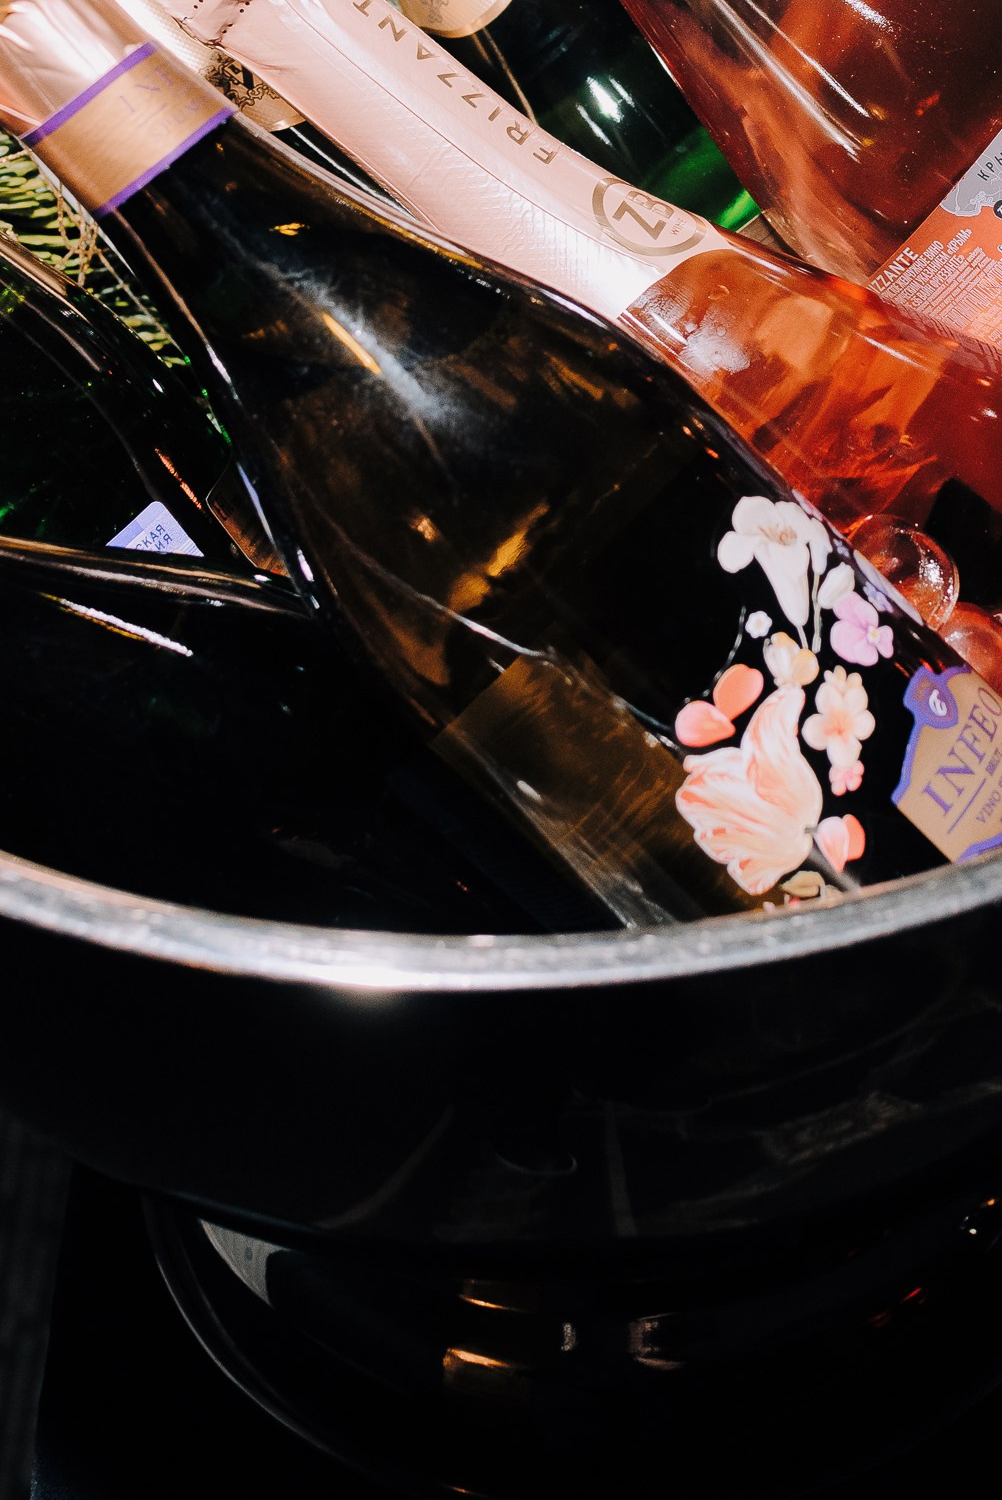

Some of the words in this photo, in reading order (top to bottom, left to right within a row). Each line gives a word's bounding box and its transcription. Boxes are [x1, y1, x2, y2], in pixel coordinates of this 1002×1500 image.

[611, 186, 674, 240] ZB
[866, 245, 918, 296] IZZANTE
[894, 254, 930, 289] ЖЕМЧУЖНОЕ
[922, 239, 944, 260] ВИНО
[915, 250, 951, 285] УКАЗАНИЕМ
[943, 225, 973, 256] «КРЫМ»
[929, 251, 965, 289] ФРИЗЗАНТЕ»
